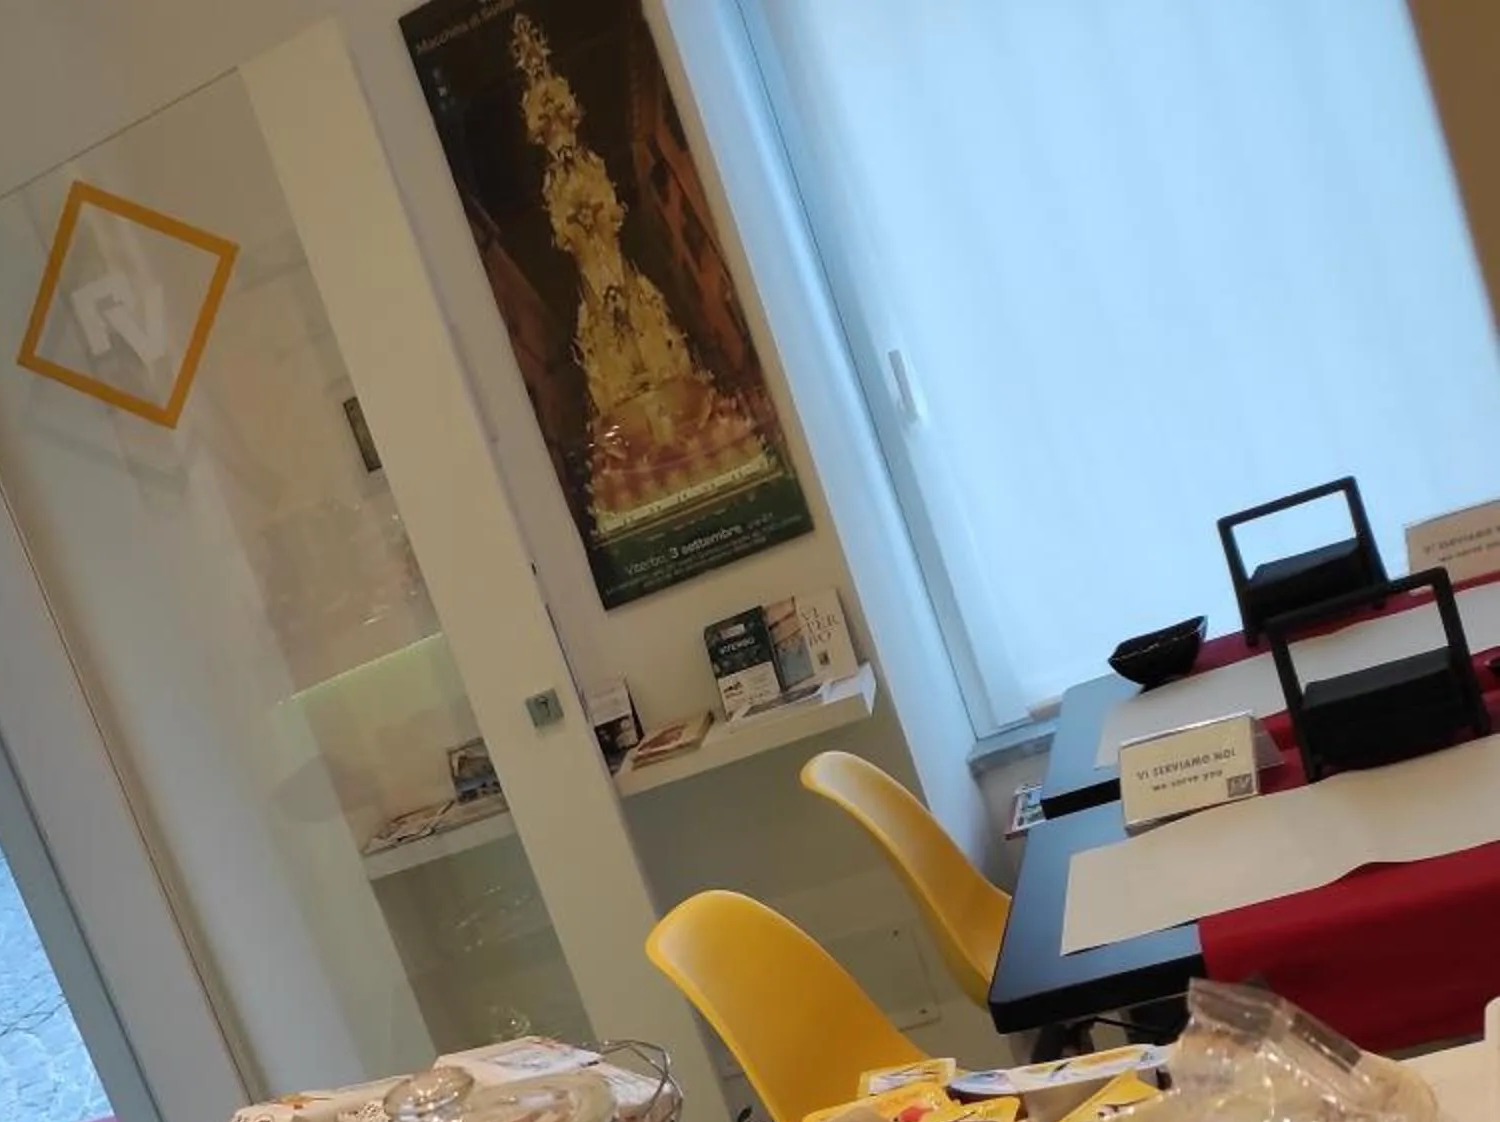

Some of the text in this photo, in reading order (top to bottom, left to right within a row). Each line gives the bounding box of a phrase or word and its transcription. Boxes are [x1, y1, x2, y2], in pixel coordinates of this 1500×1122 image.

[1136, 770, 1150, 781] VI
[1152, 753, 1211, 778] SERVIAMO
[1171, 775, 1199, 788] serve
[1202, 769, 1224, 782] you
